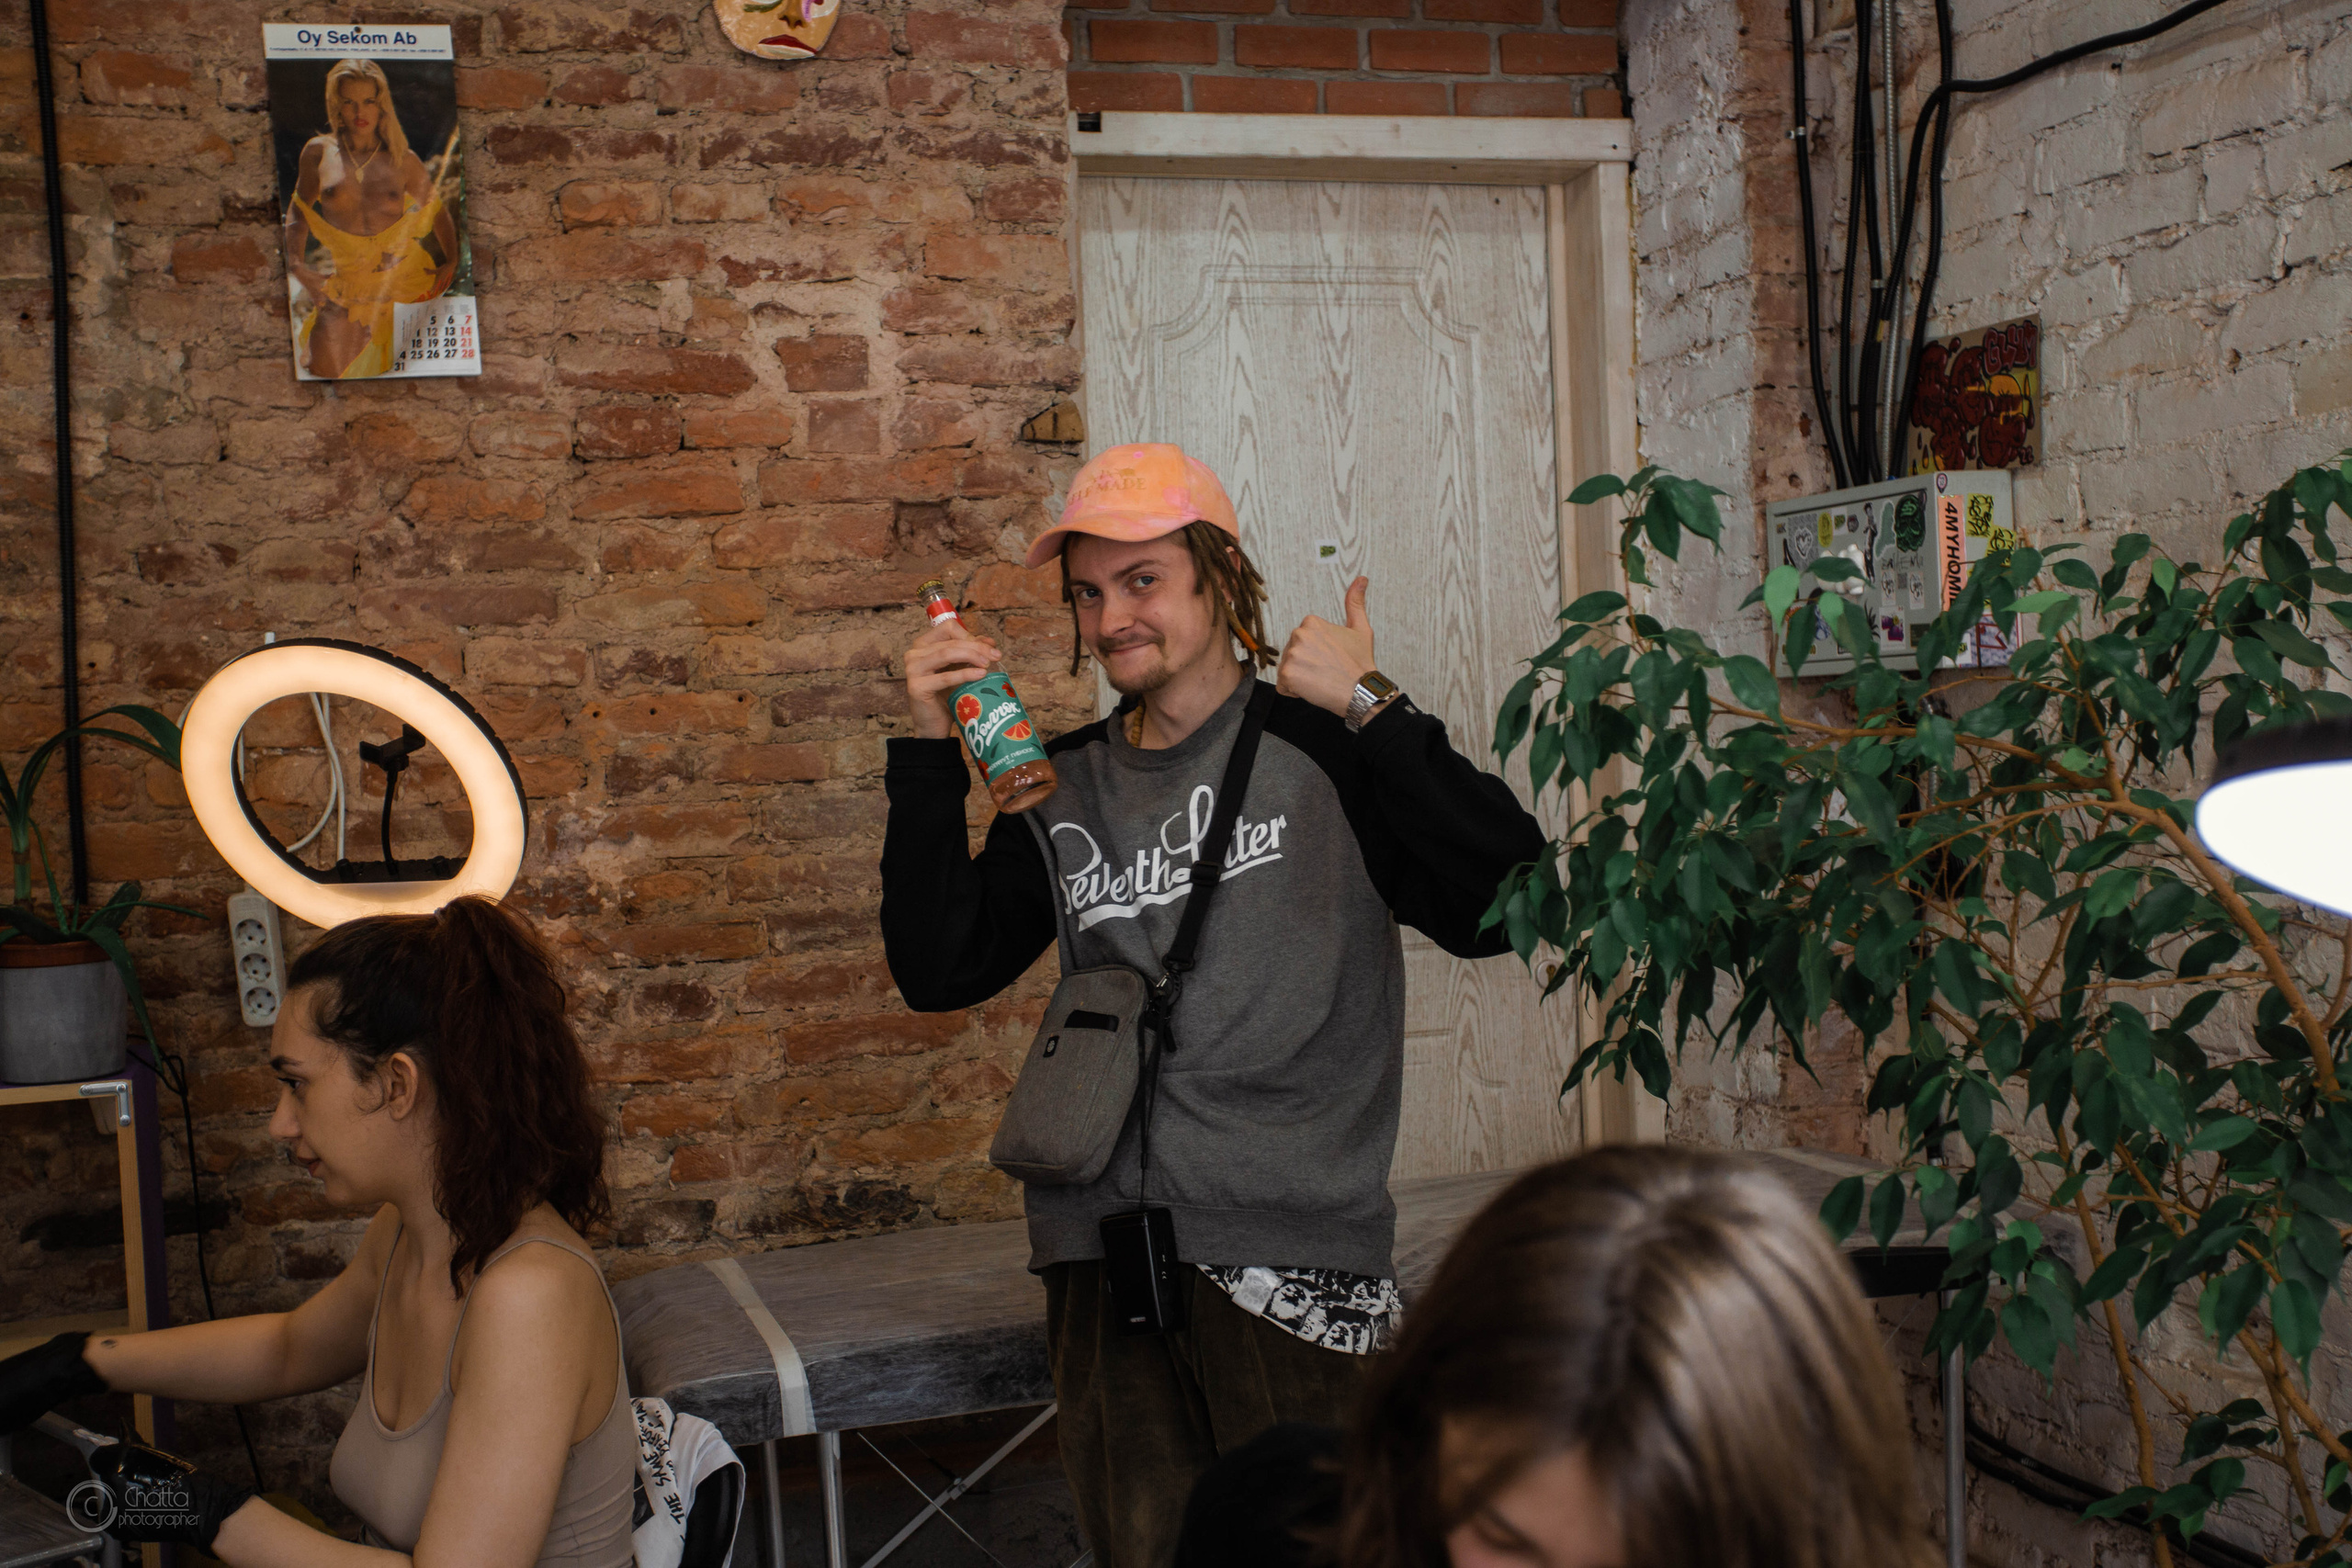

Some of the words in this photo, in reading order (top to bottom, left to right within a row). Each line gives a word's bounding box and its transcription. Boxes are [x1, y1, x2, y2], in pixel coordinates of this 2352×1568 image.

[297, 29, 322, 47] Oy
[327, 30, 388, 45] Sekom
[393, 31, 417, 45] Ab
[430, 315, 437, 325] 5
[447, 315, 454, 324] 6
[465, 314, 472, 324] 7
[427, 327, 438, 337] 12
[445, 326, 456, 336] 13
[460, 326, 472, 335] 14
[428, 338, 438, 347] 19
[444, 338, 457, 347] 20
[461, 338, 471, 347] 21
[411, 350, 424, 359] 25
[426, 349, 440, 358] 26
[445, 349, 458, 358] 27
[462, 349, 475, 358] 28
[394, 362, 405, 371] 31
[643, 1450, 672, 1487] SAME
[663, 1493, 685, 1525] THE
